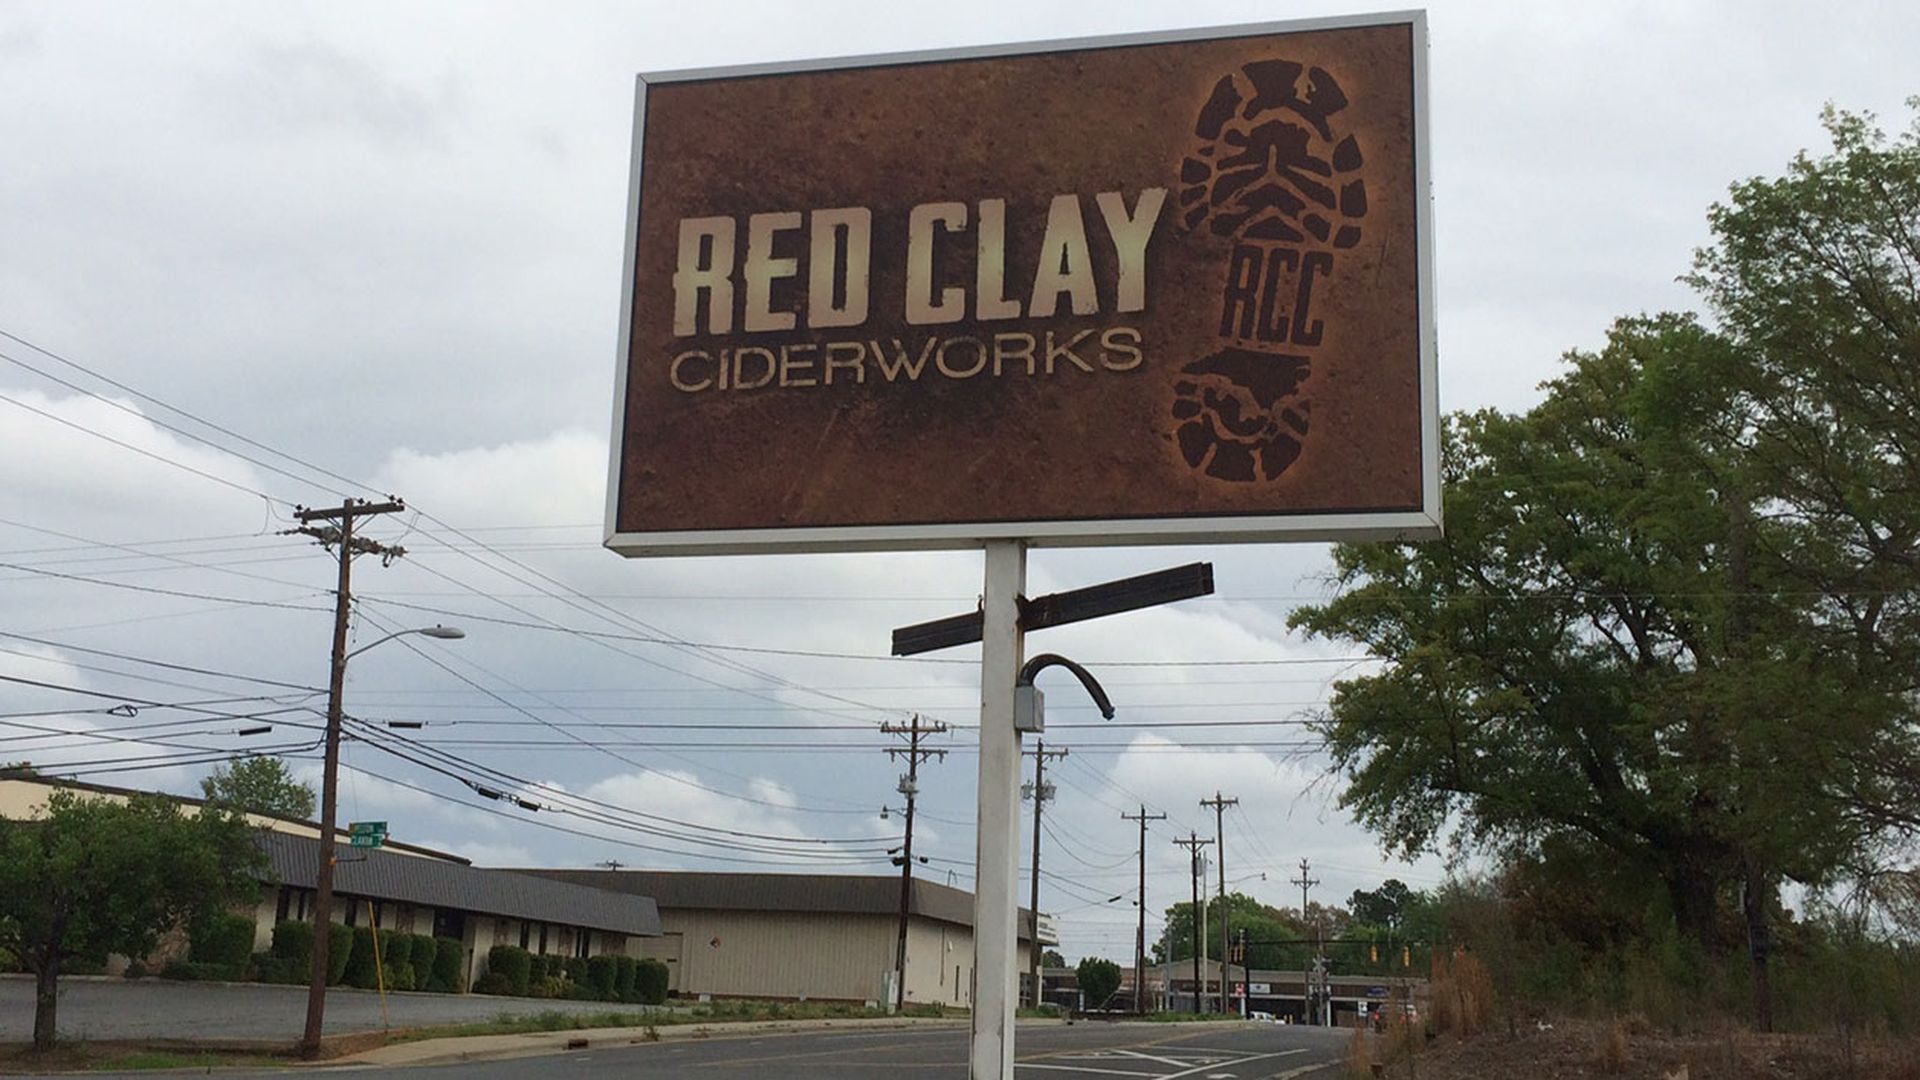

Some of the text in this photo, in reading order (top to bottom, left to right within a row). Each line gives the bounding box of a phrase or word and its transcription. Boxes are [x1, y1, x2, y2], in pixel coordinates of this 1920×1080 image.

[672, 187, 1168, 337] RED CLAY
[1219, 244, 1334, 347] RCC
[669, 326, 1143, 392] CIDERWORKS
